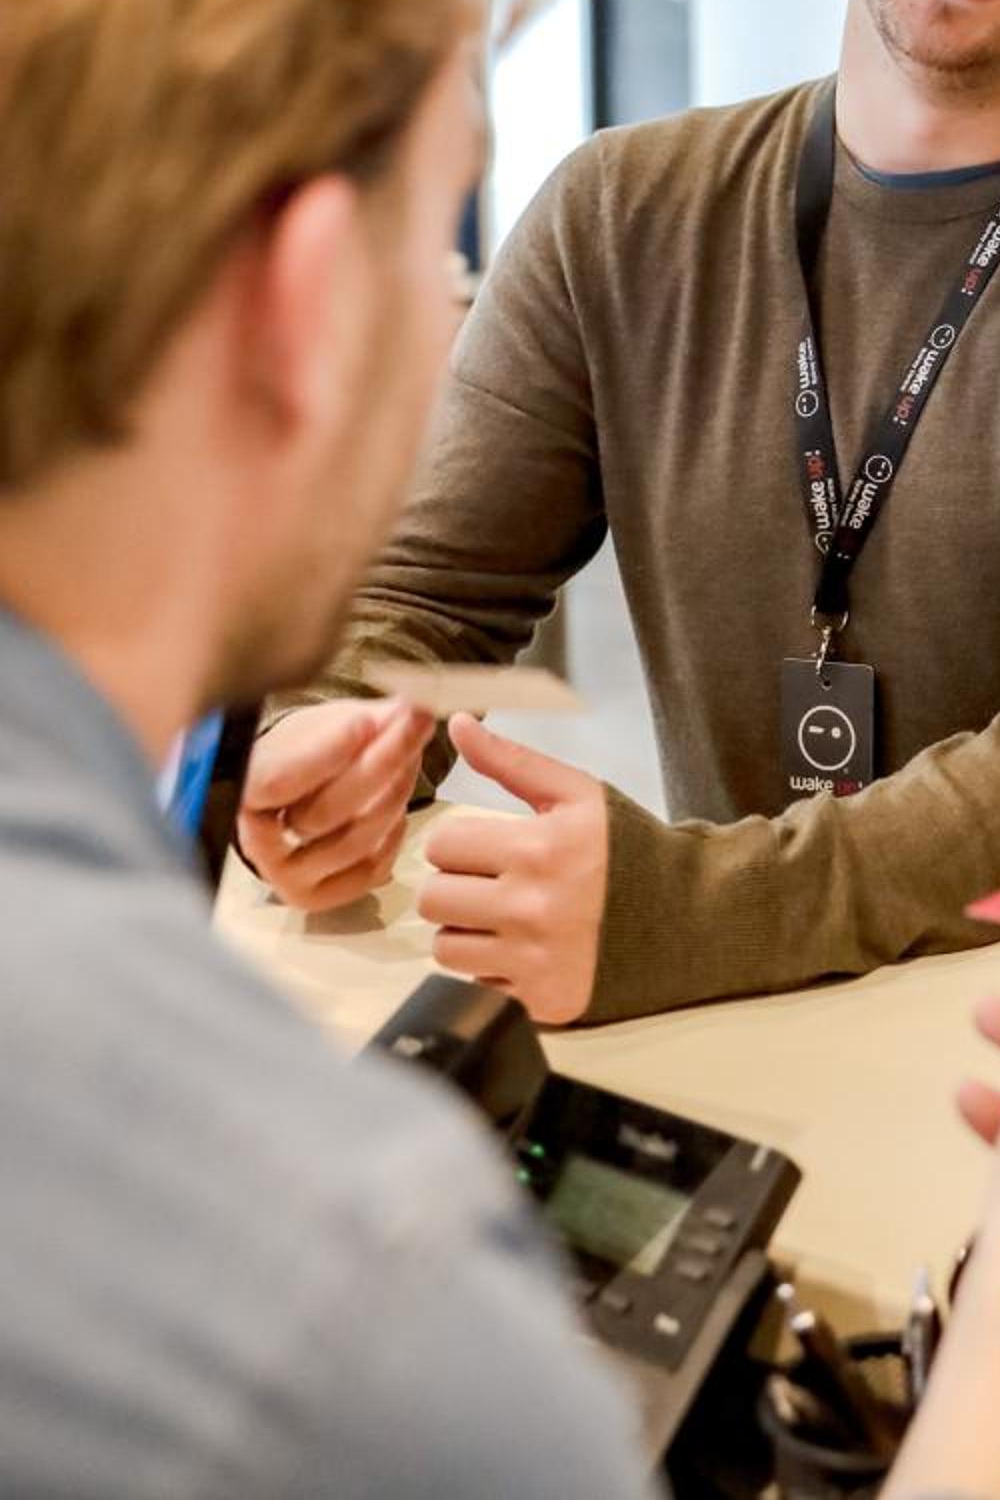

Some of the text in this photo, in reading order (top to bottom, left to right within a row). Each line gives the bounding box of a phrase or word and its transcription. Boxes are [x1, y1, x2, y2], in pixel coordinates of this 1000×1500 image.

[910, 350, 939, 396] wake
[811, 481, 831, 534] wake
[848, 482, 879, 531] wake
[789, 775, 834, 792] wake
